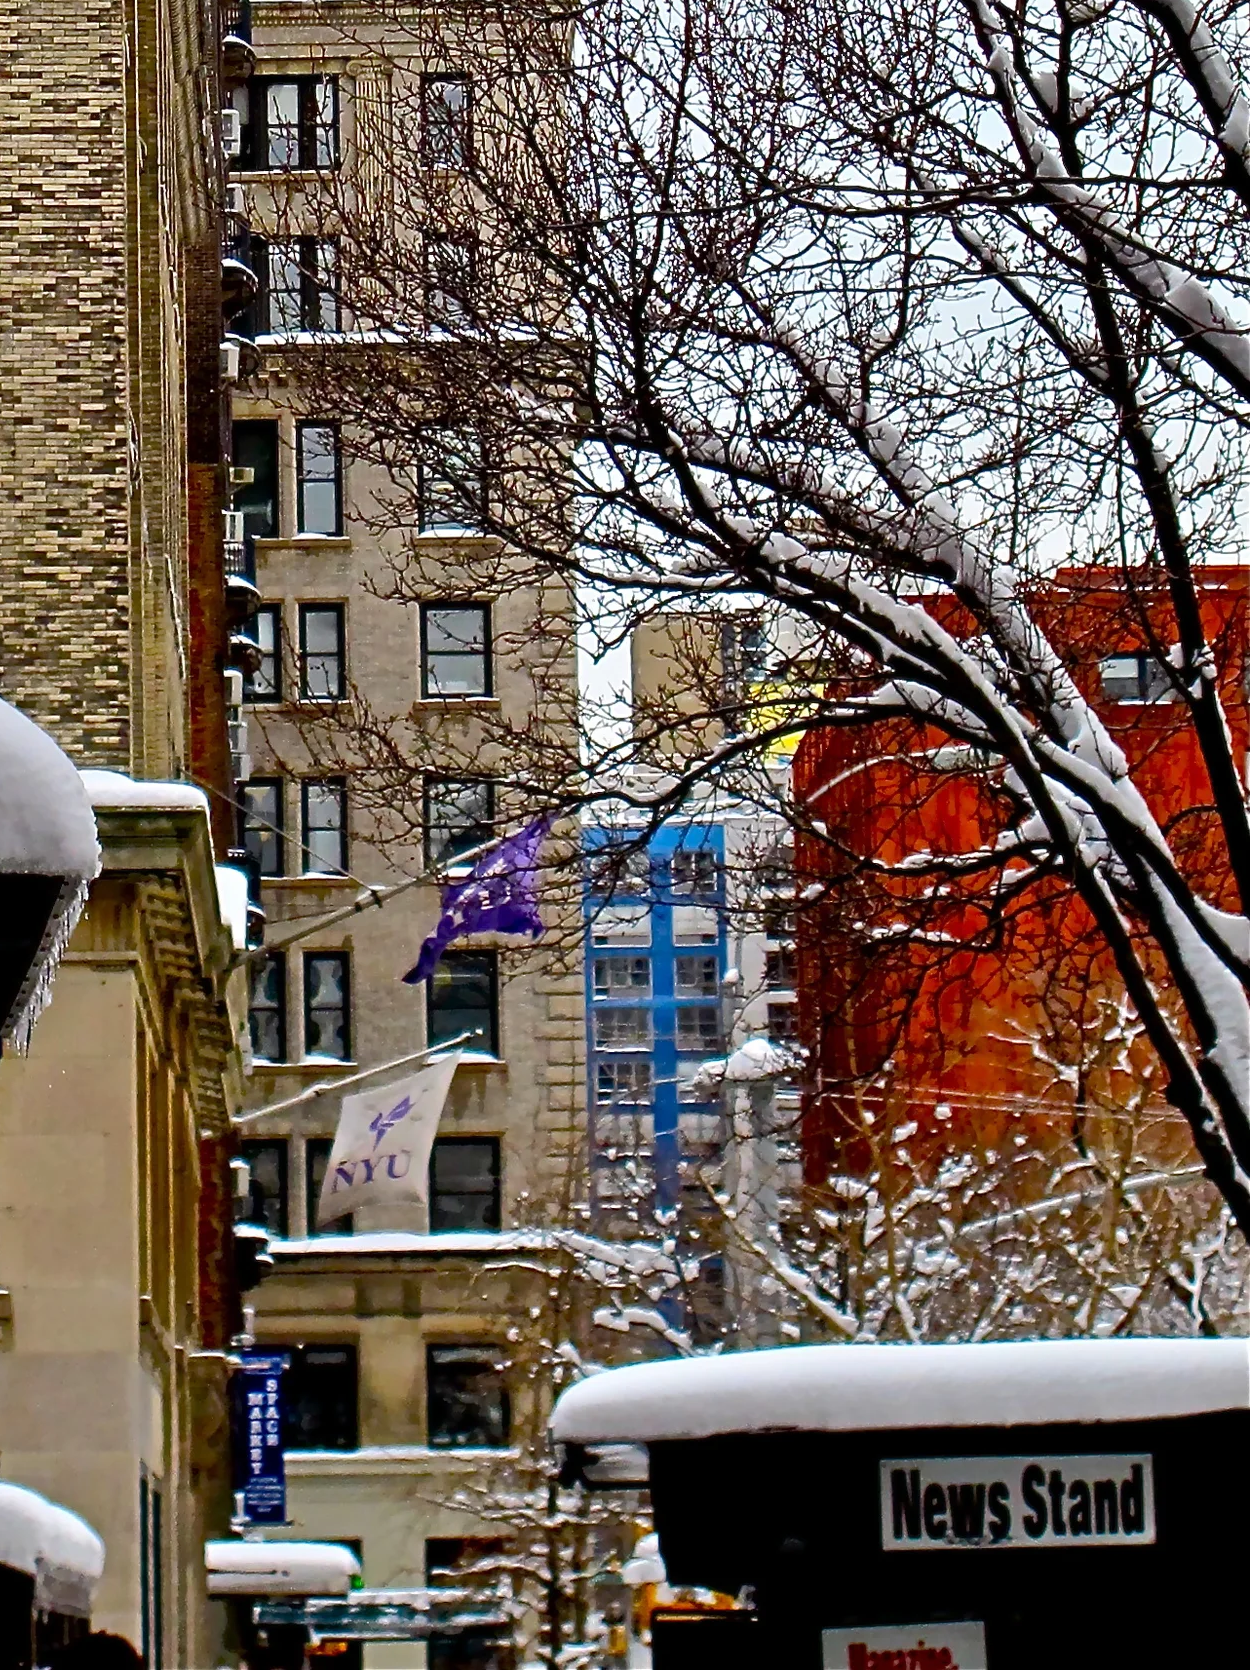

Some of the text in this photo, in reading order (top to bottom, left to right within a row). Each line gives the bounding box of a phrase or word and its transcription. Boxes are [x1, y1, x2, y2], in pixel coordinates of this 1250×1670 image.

[331, 1150, 412, 1194] NYU
[891, 1463, 1144, 1541] News Stand
